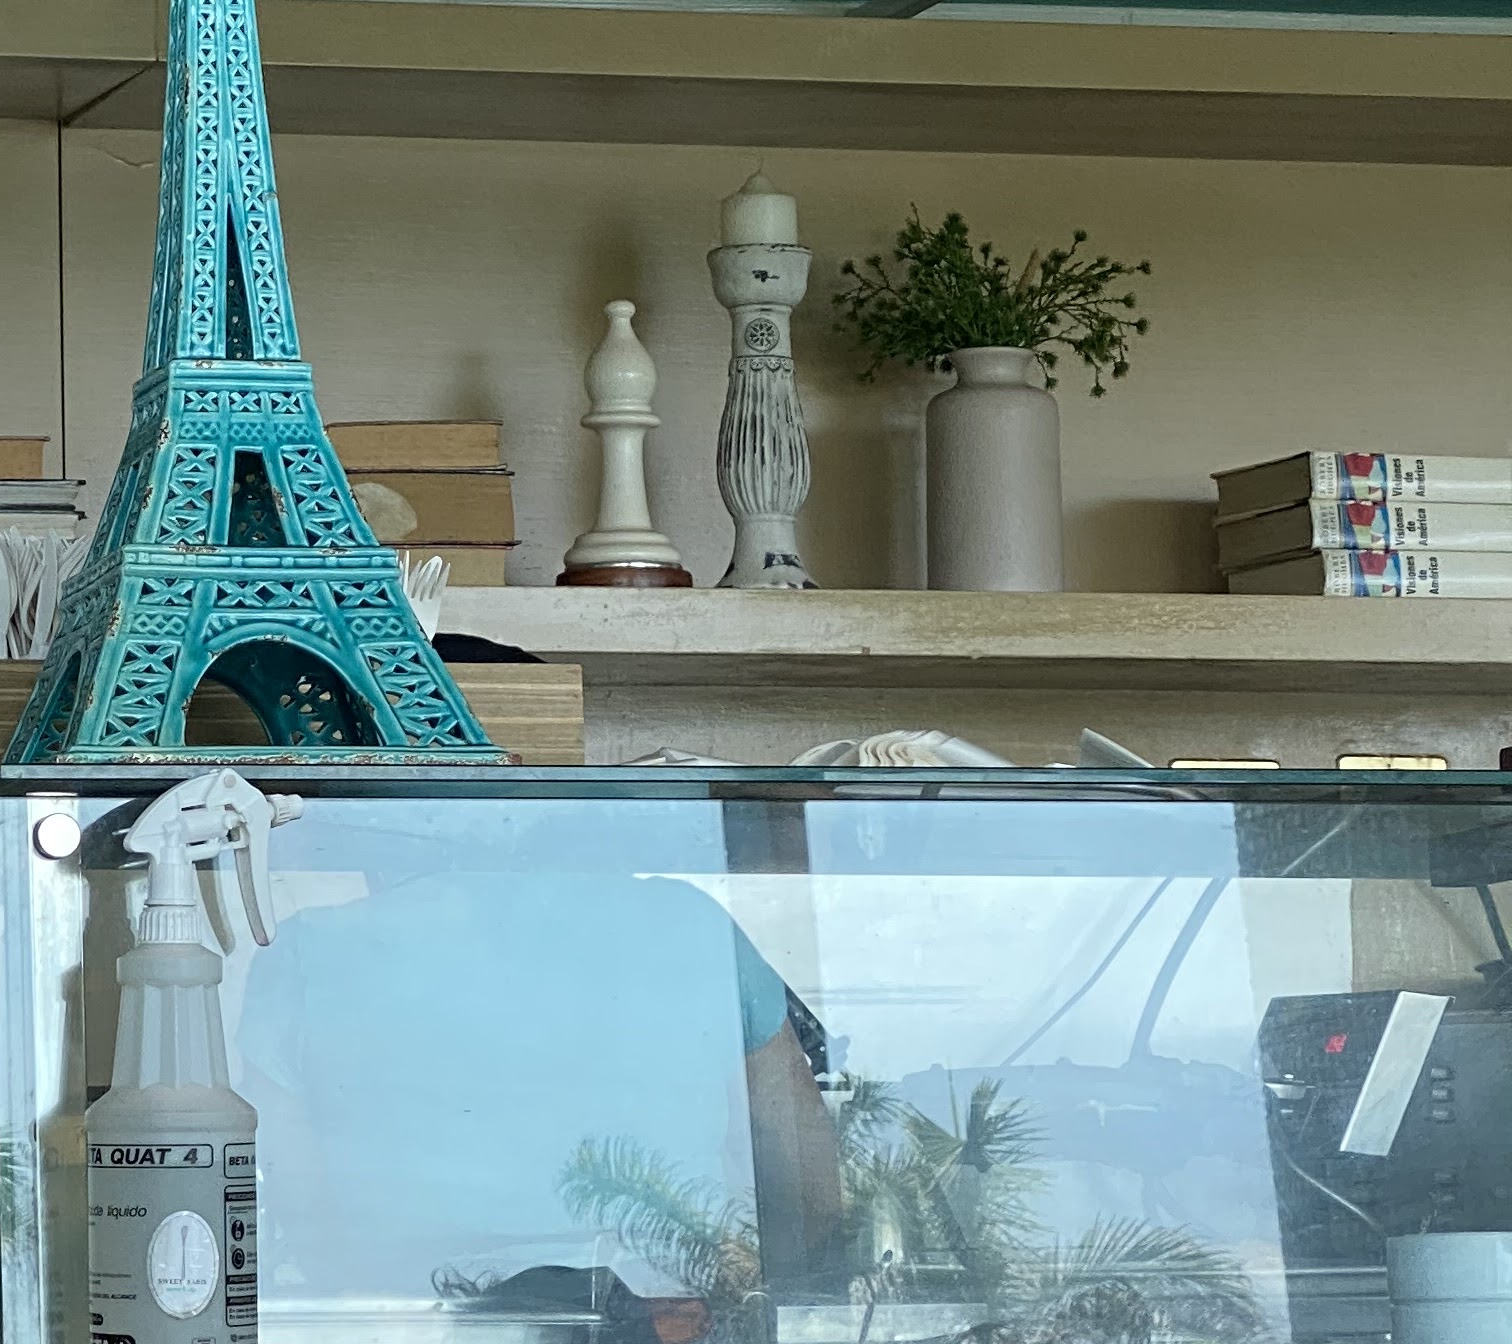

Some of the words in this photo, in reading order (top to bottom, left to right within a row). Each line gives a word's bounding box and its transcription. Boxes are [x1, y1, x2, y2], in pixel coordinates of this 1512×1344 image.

[1392, 458, 1402, 497] Visiones
[1405, 471, 1414, 483] de
[1415, 459, 1425, 497] América
[1395, 507, 1406, 546] Visiones
[1406, 521, 1416, 532] de
[1418, 508, 1428, 546] América
[1406, 555, 1416, 595] Visiones
[1418, 570, 1427, 581] de
[1429, 557, 1439, 595] América
[110, 1147, 172, 1166] QUAT
[183, 1147, 199, 1165] 4
[229, 1155, 249, 1166] BETA
